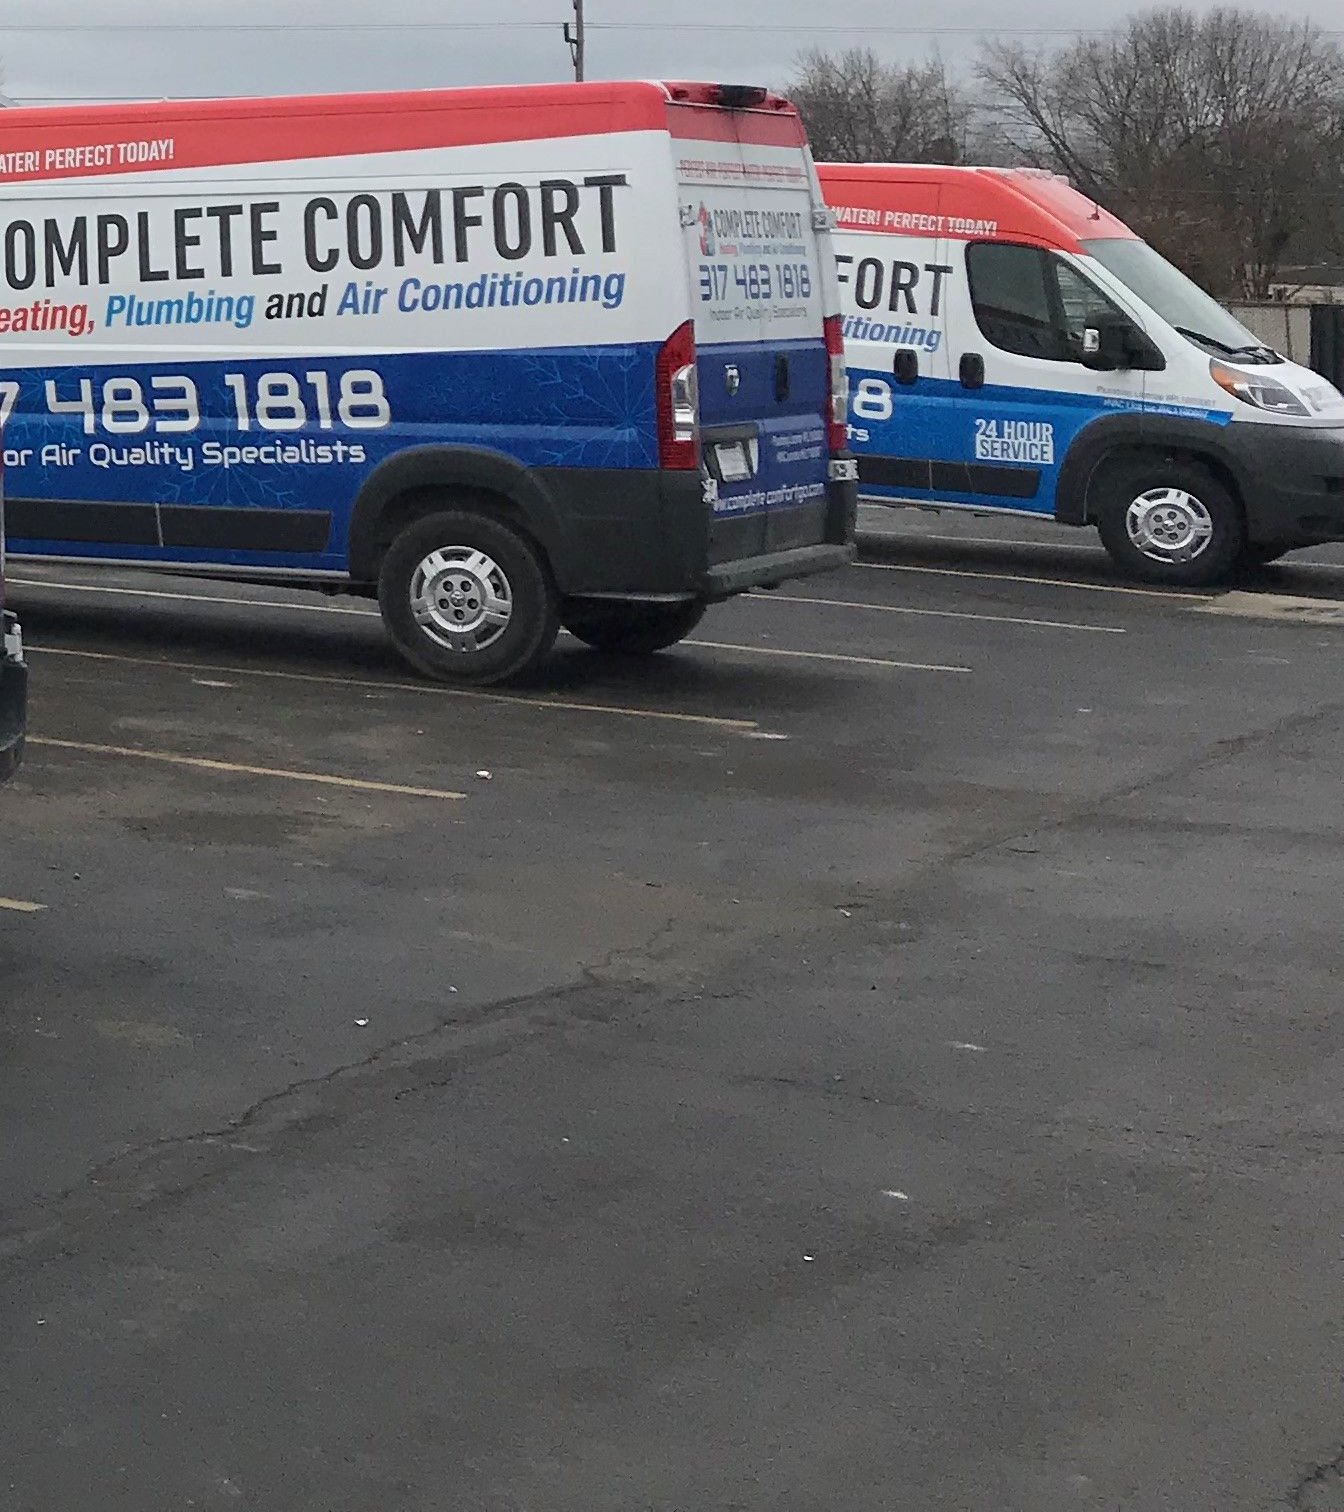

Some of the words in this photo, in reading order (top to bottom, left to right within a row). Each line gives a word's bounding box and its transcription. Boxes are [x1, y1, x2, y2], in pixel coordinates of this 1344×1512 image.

[45, 145, 114, 171] PERFECT
[117, 139, 174, 164] TODAY!
[304, 174, 627, 273] COMFORT
[832, 206, 880, 225] WATER!
[884, 211, 944, 231] PERFECT
[947, 218, 998, 237] TODAY!
[105, 289, 256, 328] Plumbing
[265, 284, 328, 320] and
[337, 280, 389, 316] Air
[397, 267, 626, 312] Conditioning
[699, 265, 728, 301] 317
[734, 265, 771, 299] 483
[775, 264, 811, 299] 1818
[45, 376, 200, 434] 483
[225, 370, 392, 431] 1818
[975, 418, 997, 440] 24
[1001, 421, 1053, 444] HOUR
[41, 444, 76, 465] Air
[90, 442, 193, 471] Quality
[203, 439, 366, 468] Specialists
[979, 438, 1052, 461] SERVICE
